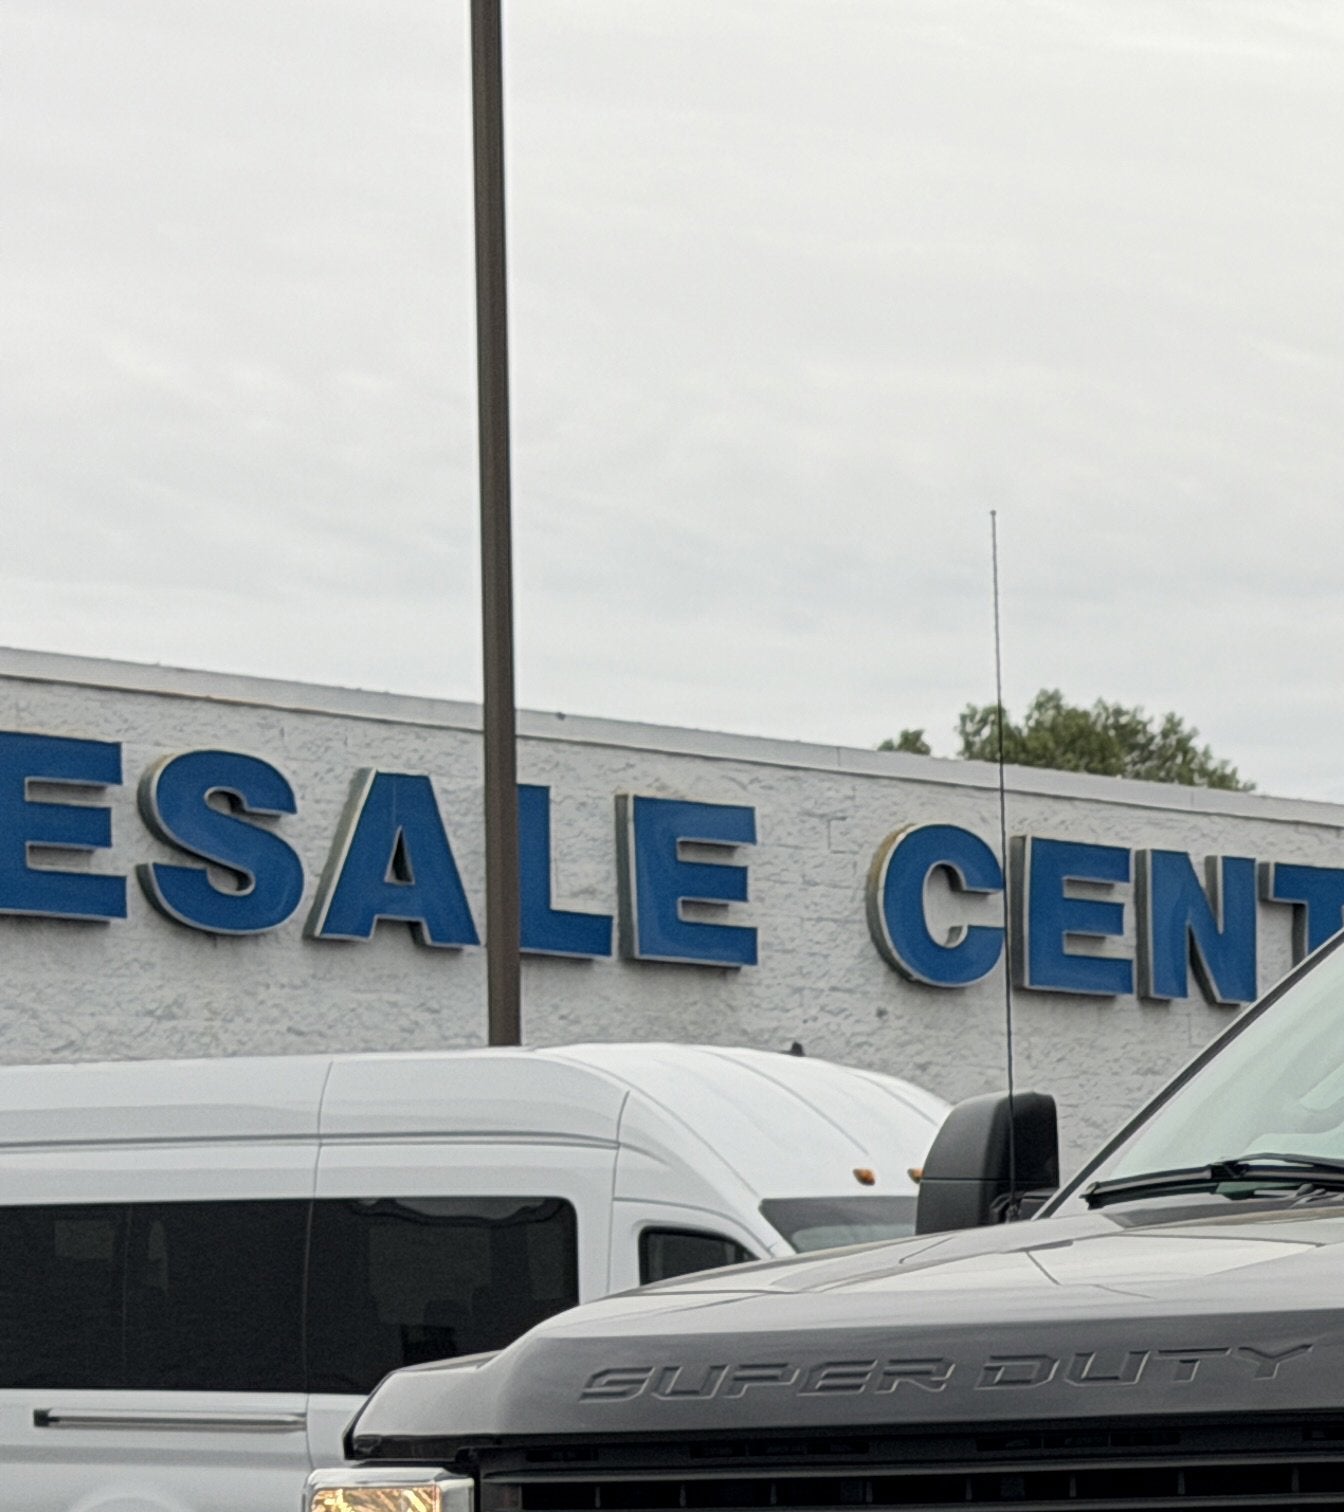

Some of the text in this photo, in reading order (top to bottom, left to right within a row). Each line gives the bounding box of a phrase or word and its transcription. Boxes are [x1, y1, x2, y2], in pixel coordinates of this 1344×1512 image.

[0, 731, 760, 969] ESALE
[578, 1343, 1315, 1403] SUPER DUTY
